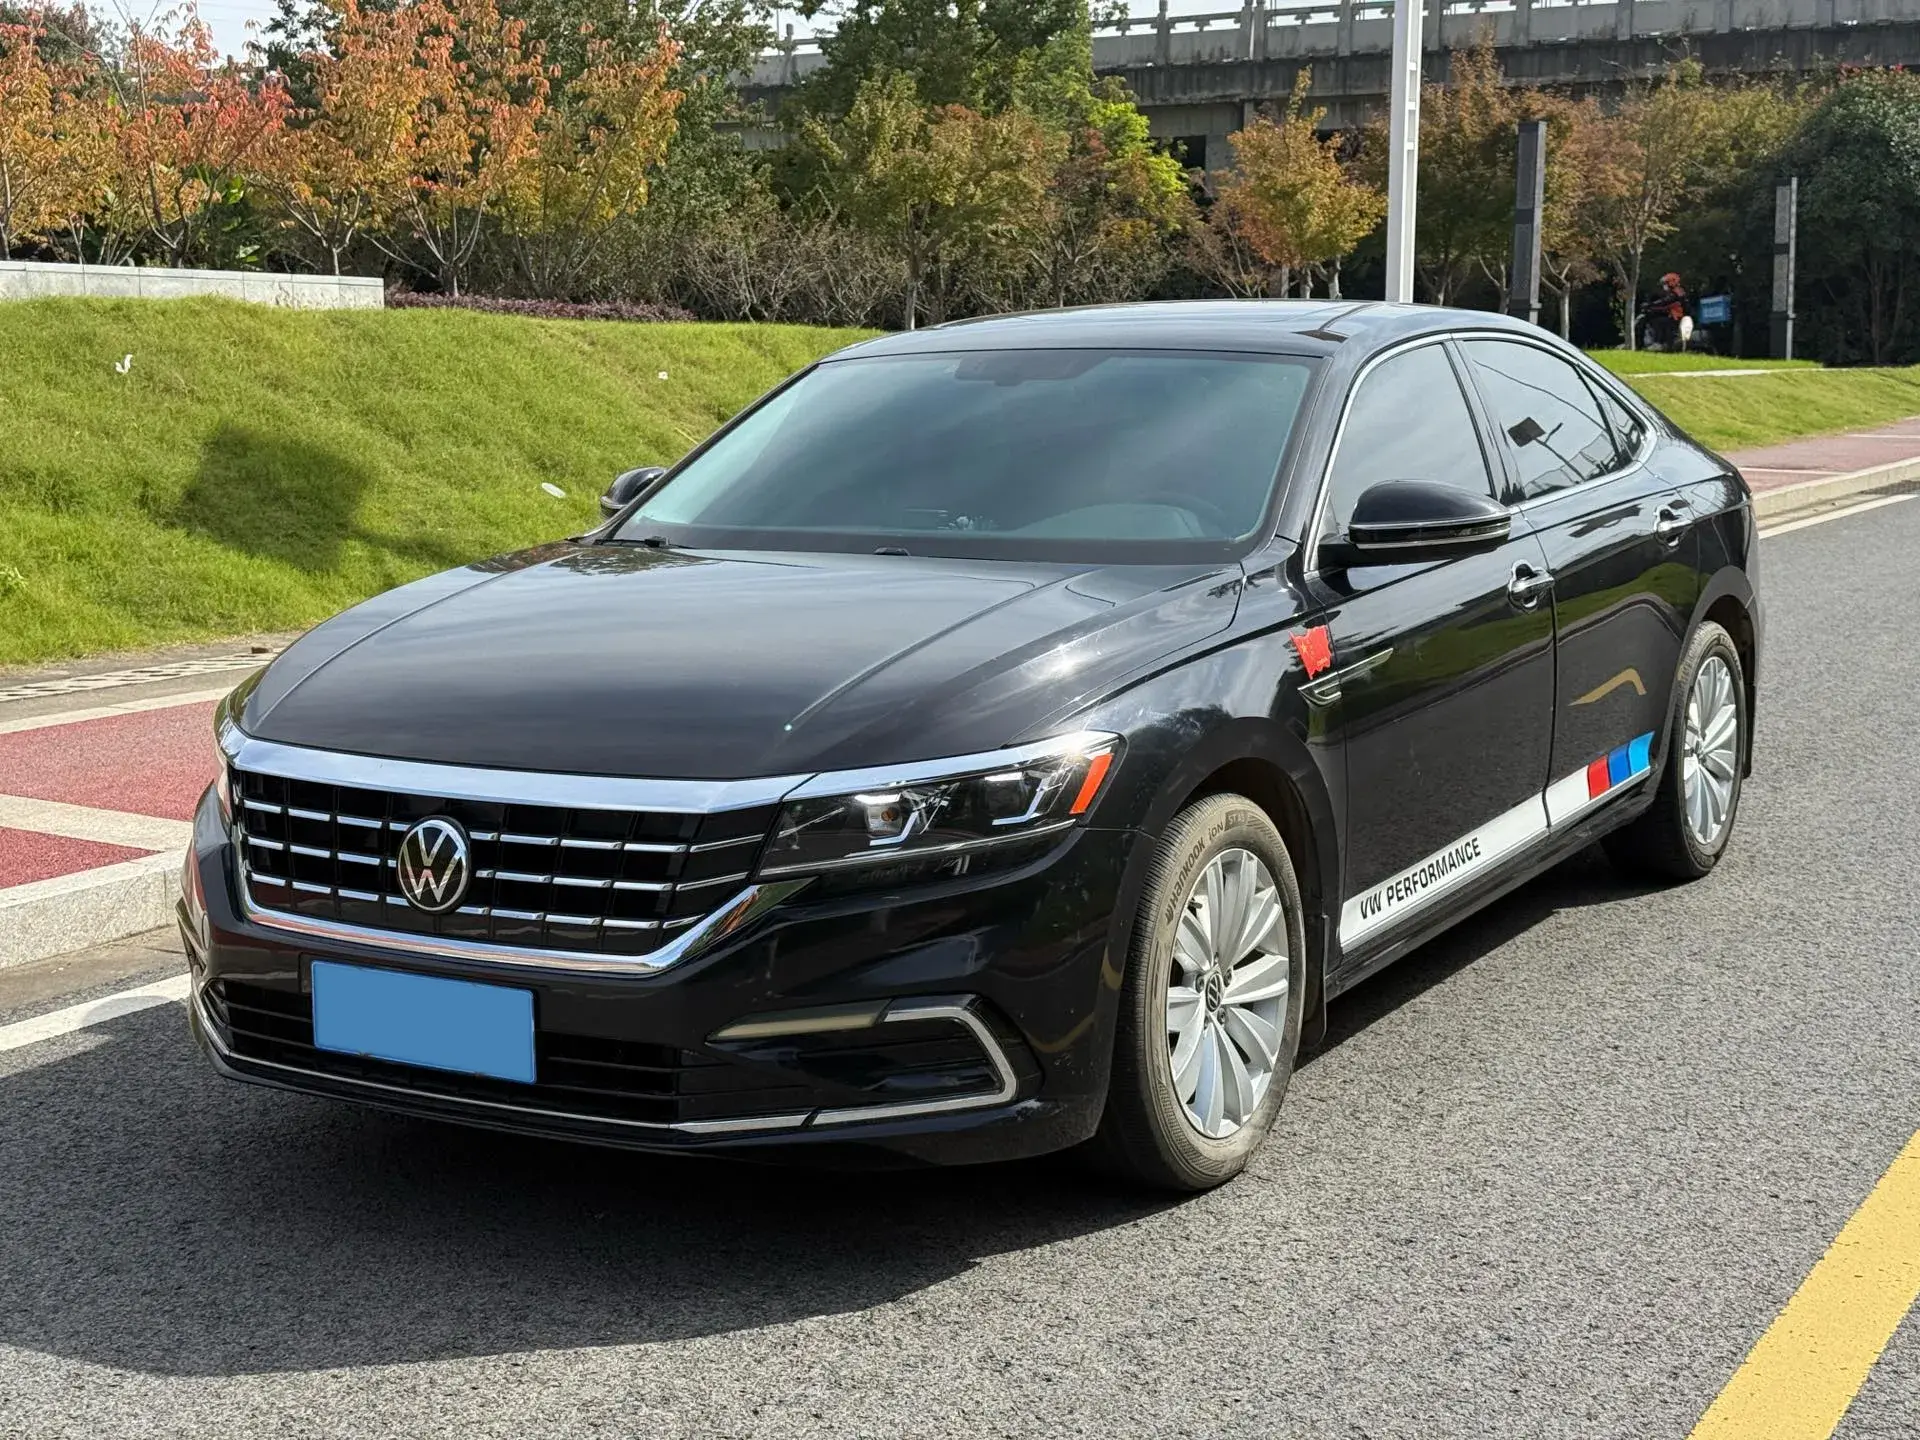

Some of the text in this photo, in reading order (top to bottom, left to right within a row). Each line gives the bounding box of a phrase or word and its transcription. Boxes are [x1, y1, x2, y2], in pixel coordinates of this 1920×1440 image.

[398, 819, 467, 911] VW
[1360, 837, 1481, 919] VW PERFORMANCE
